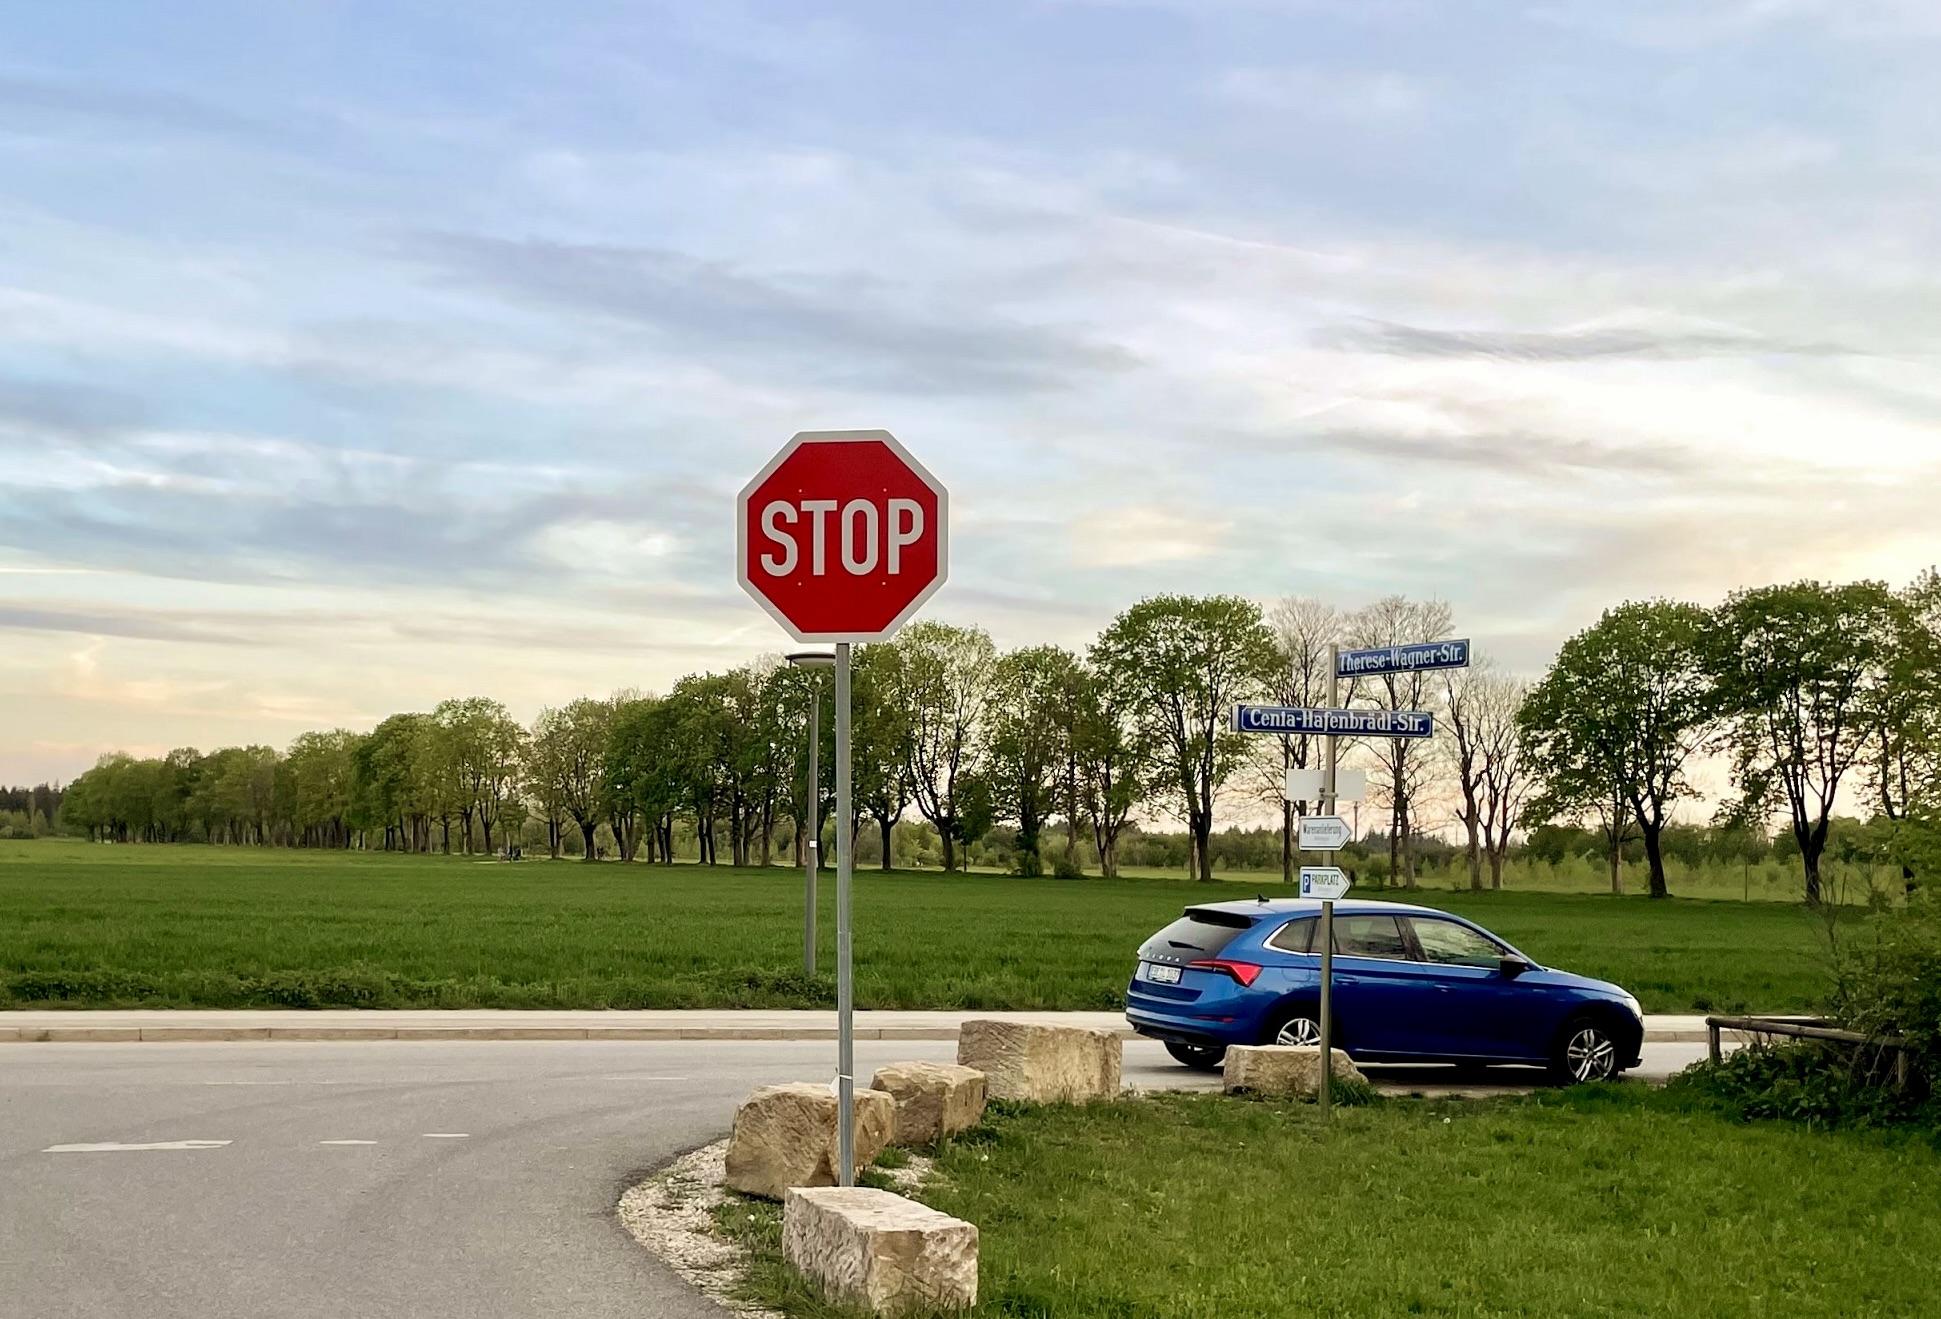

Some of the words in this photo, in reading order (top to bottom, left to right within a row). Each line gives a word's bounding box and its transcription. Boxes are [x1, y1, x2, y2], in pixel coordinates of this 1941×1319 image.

[760, 498, 924, 577] STOP
[1339, 644, 1463, 673] Therese-Wagner-Str.
[1250, 708, 1425, 732] Centa-Hafenbrädl-Str.
[1312, 874, 1339, 886] PARKPLATZ
